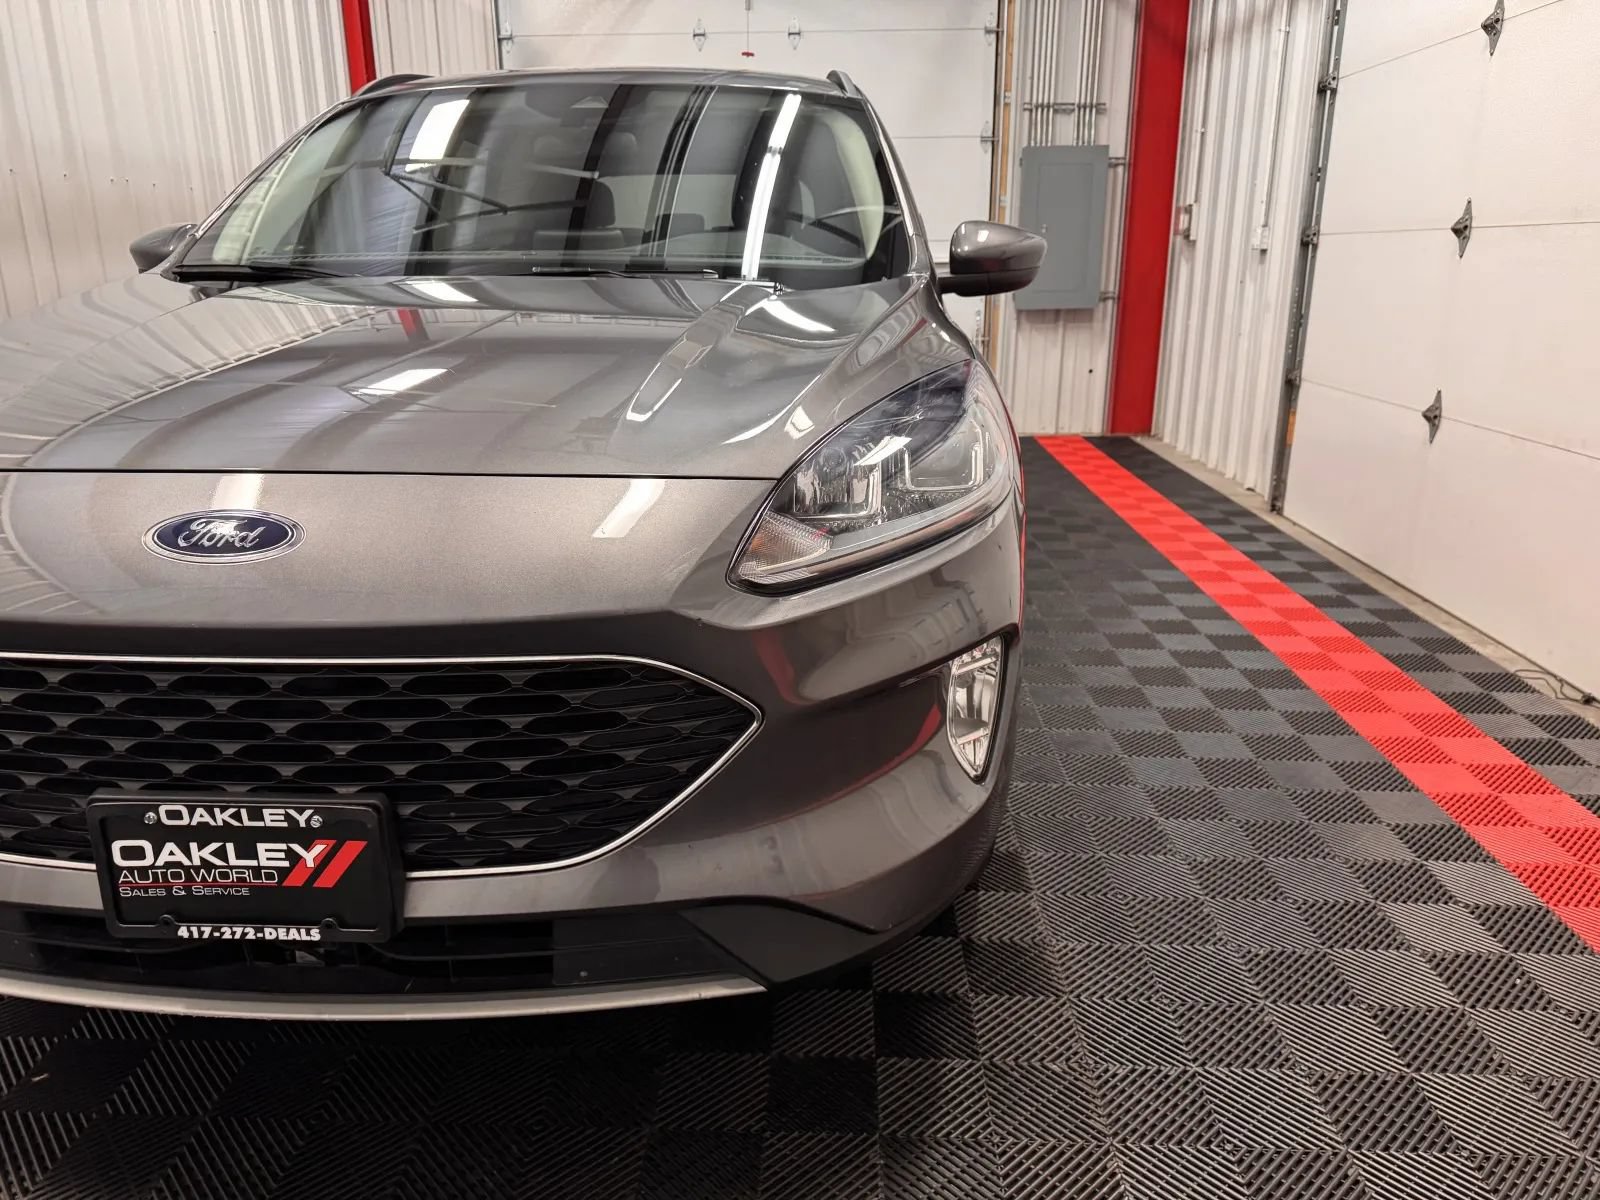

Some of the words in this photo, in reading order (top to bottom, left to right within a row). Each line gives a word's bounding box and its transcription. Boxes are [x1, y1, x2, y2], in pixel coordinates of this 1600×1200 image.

[177, 518, 266, 548] Ford
[158, 804, 315, 828] OAKLEY
[111, 839, 328, 868] OAKLEY
[118, 869, 185, 884] AUTO
[191, 868, 279, 884] WORLD
[119, 886, 166, 897] SALES
[172, 885, 187, 896] &
[192, 885, 250, 896] SERVICE
[177, 926, 321, 941] 417-272-DEALS
